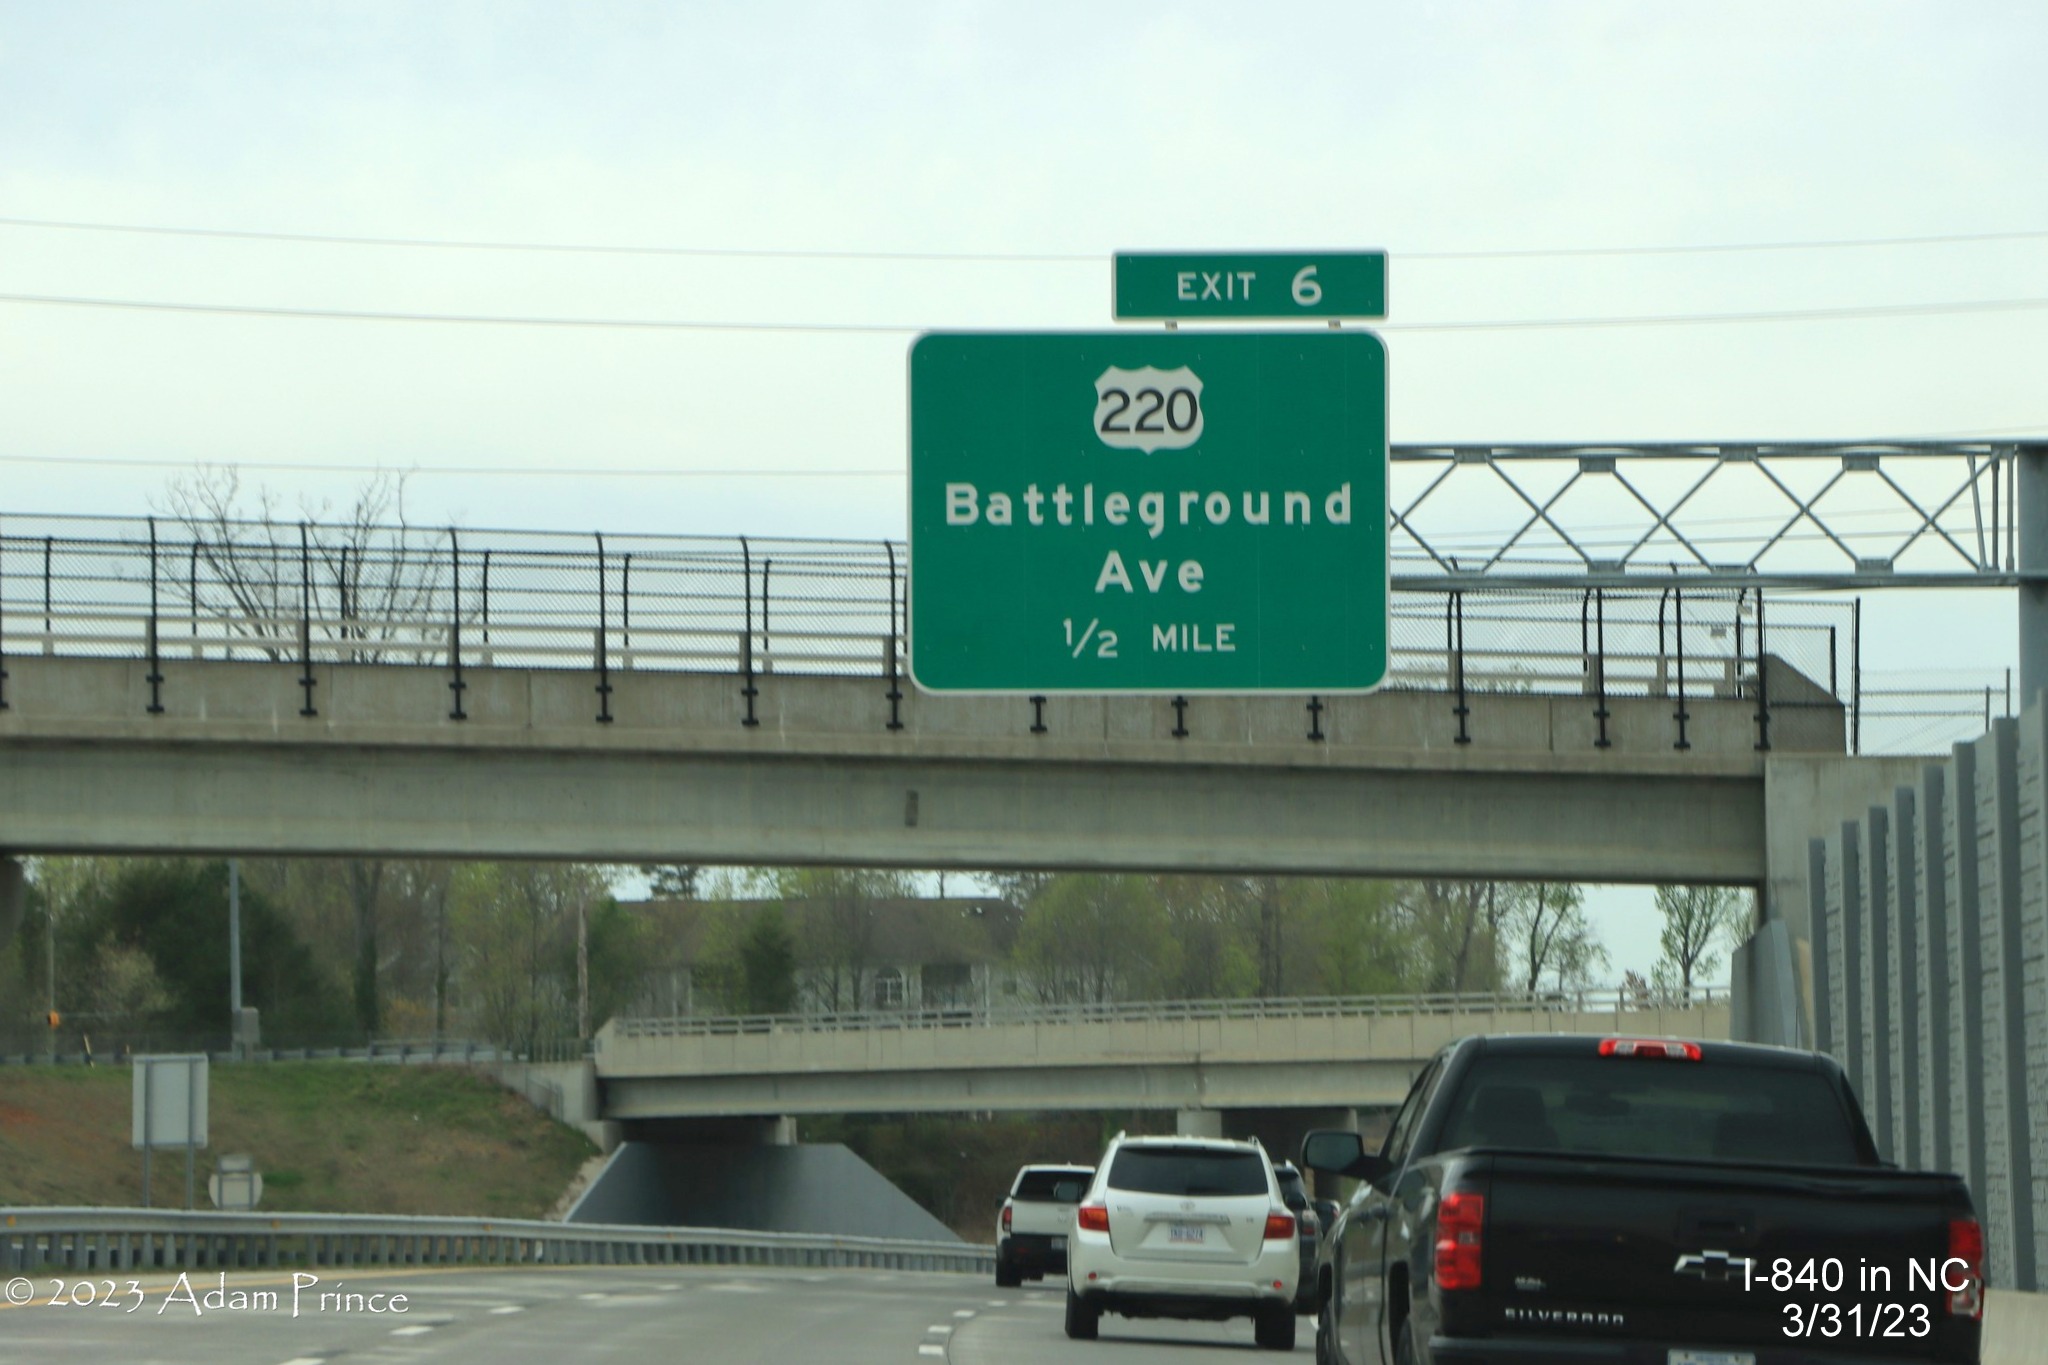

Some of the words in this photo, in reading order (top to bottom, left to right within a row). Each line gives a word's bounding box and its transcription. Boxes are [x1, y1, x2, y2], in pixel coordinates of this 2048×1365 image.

[1177, 272, 1256, 300] EXIT
[1291, 265, 1322, 305] 6
[1100, 388, 1198, 433] 220
[946, 482, 1351, 539] Battleground
[1095, 551, 1204, 593] Ave
[1063, 618, 1118, 658] 1/2
[1152, 624, 1236, 651] MILE
